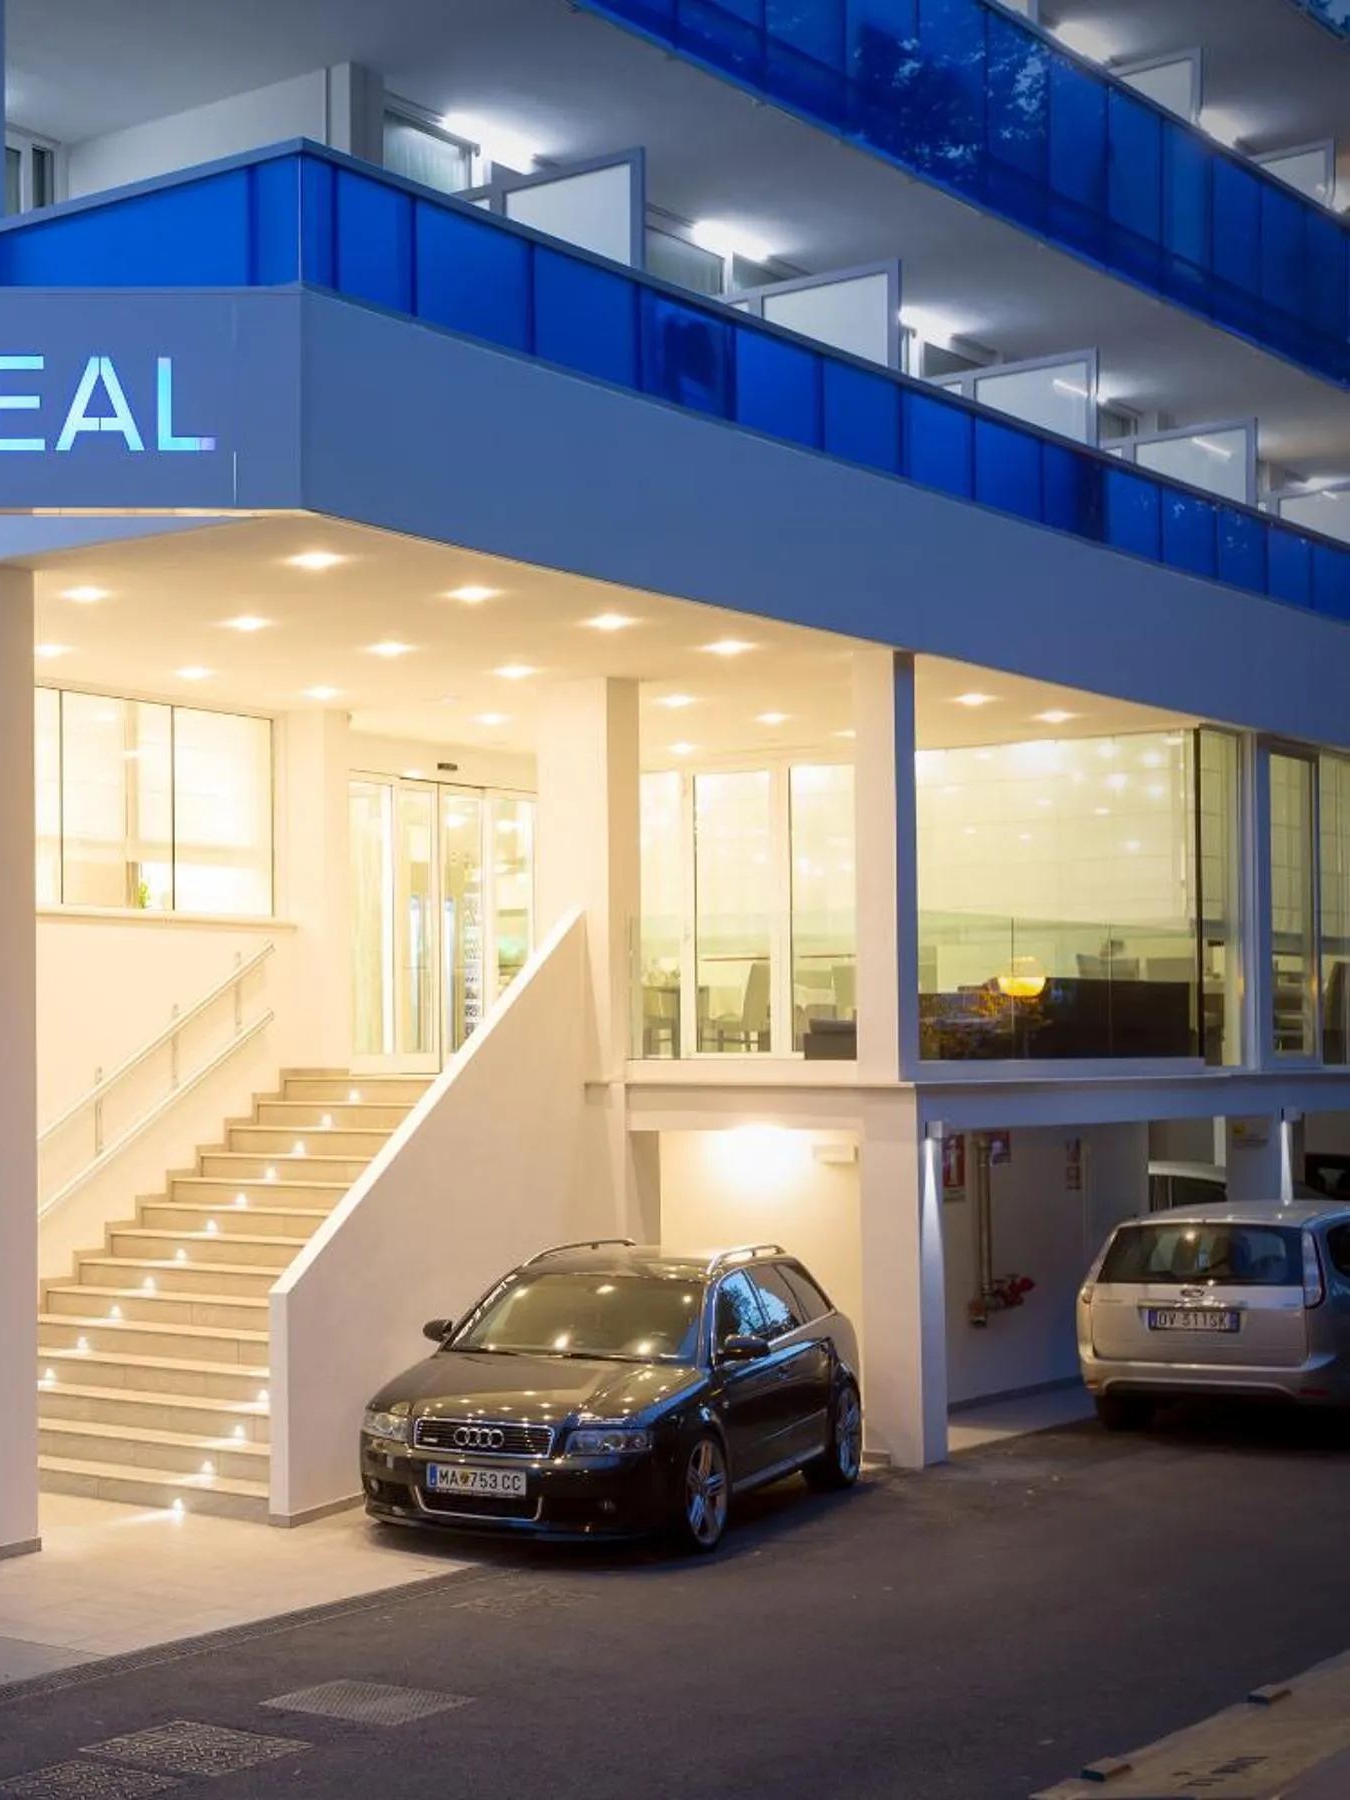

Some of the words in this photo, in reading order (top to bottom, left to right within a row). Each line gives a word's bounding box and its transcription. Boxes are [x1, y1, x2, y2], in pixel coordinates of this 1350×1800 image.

[439, 1469, 459, 1486] MA
[470, 1472, 498, 1489] 753
[502, 1474, 522, 1491] CC
